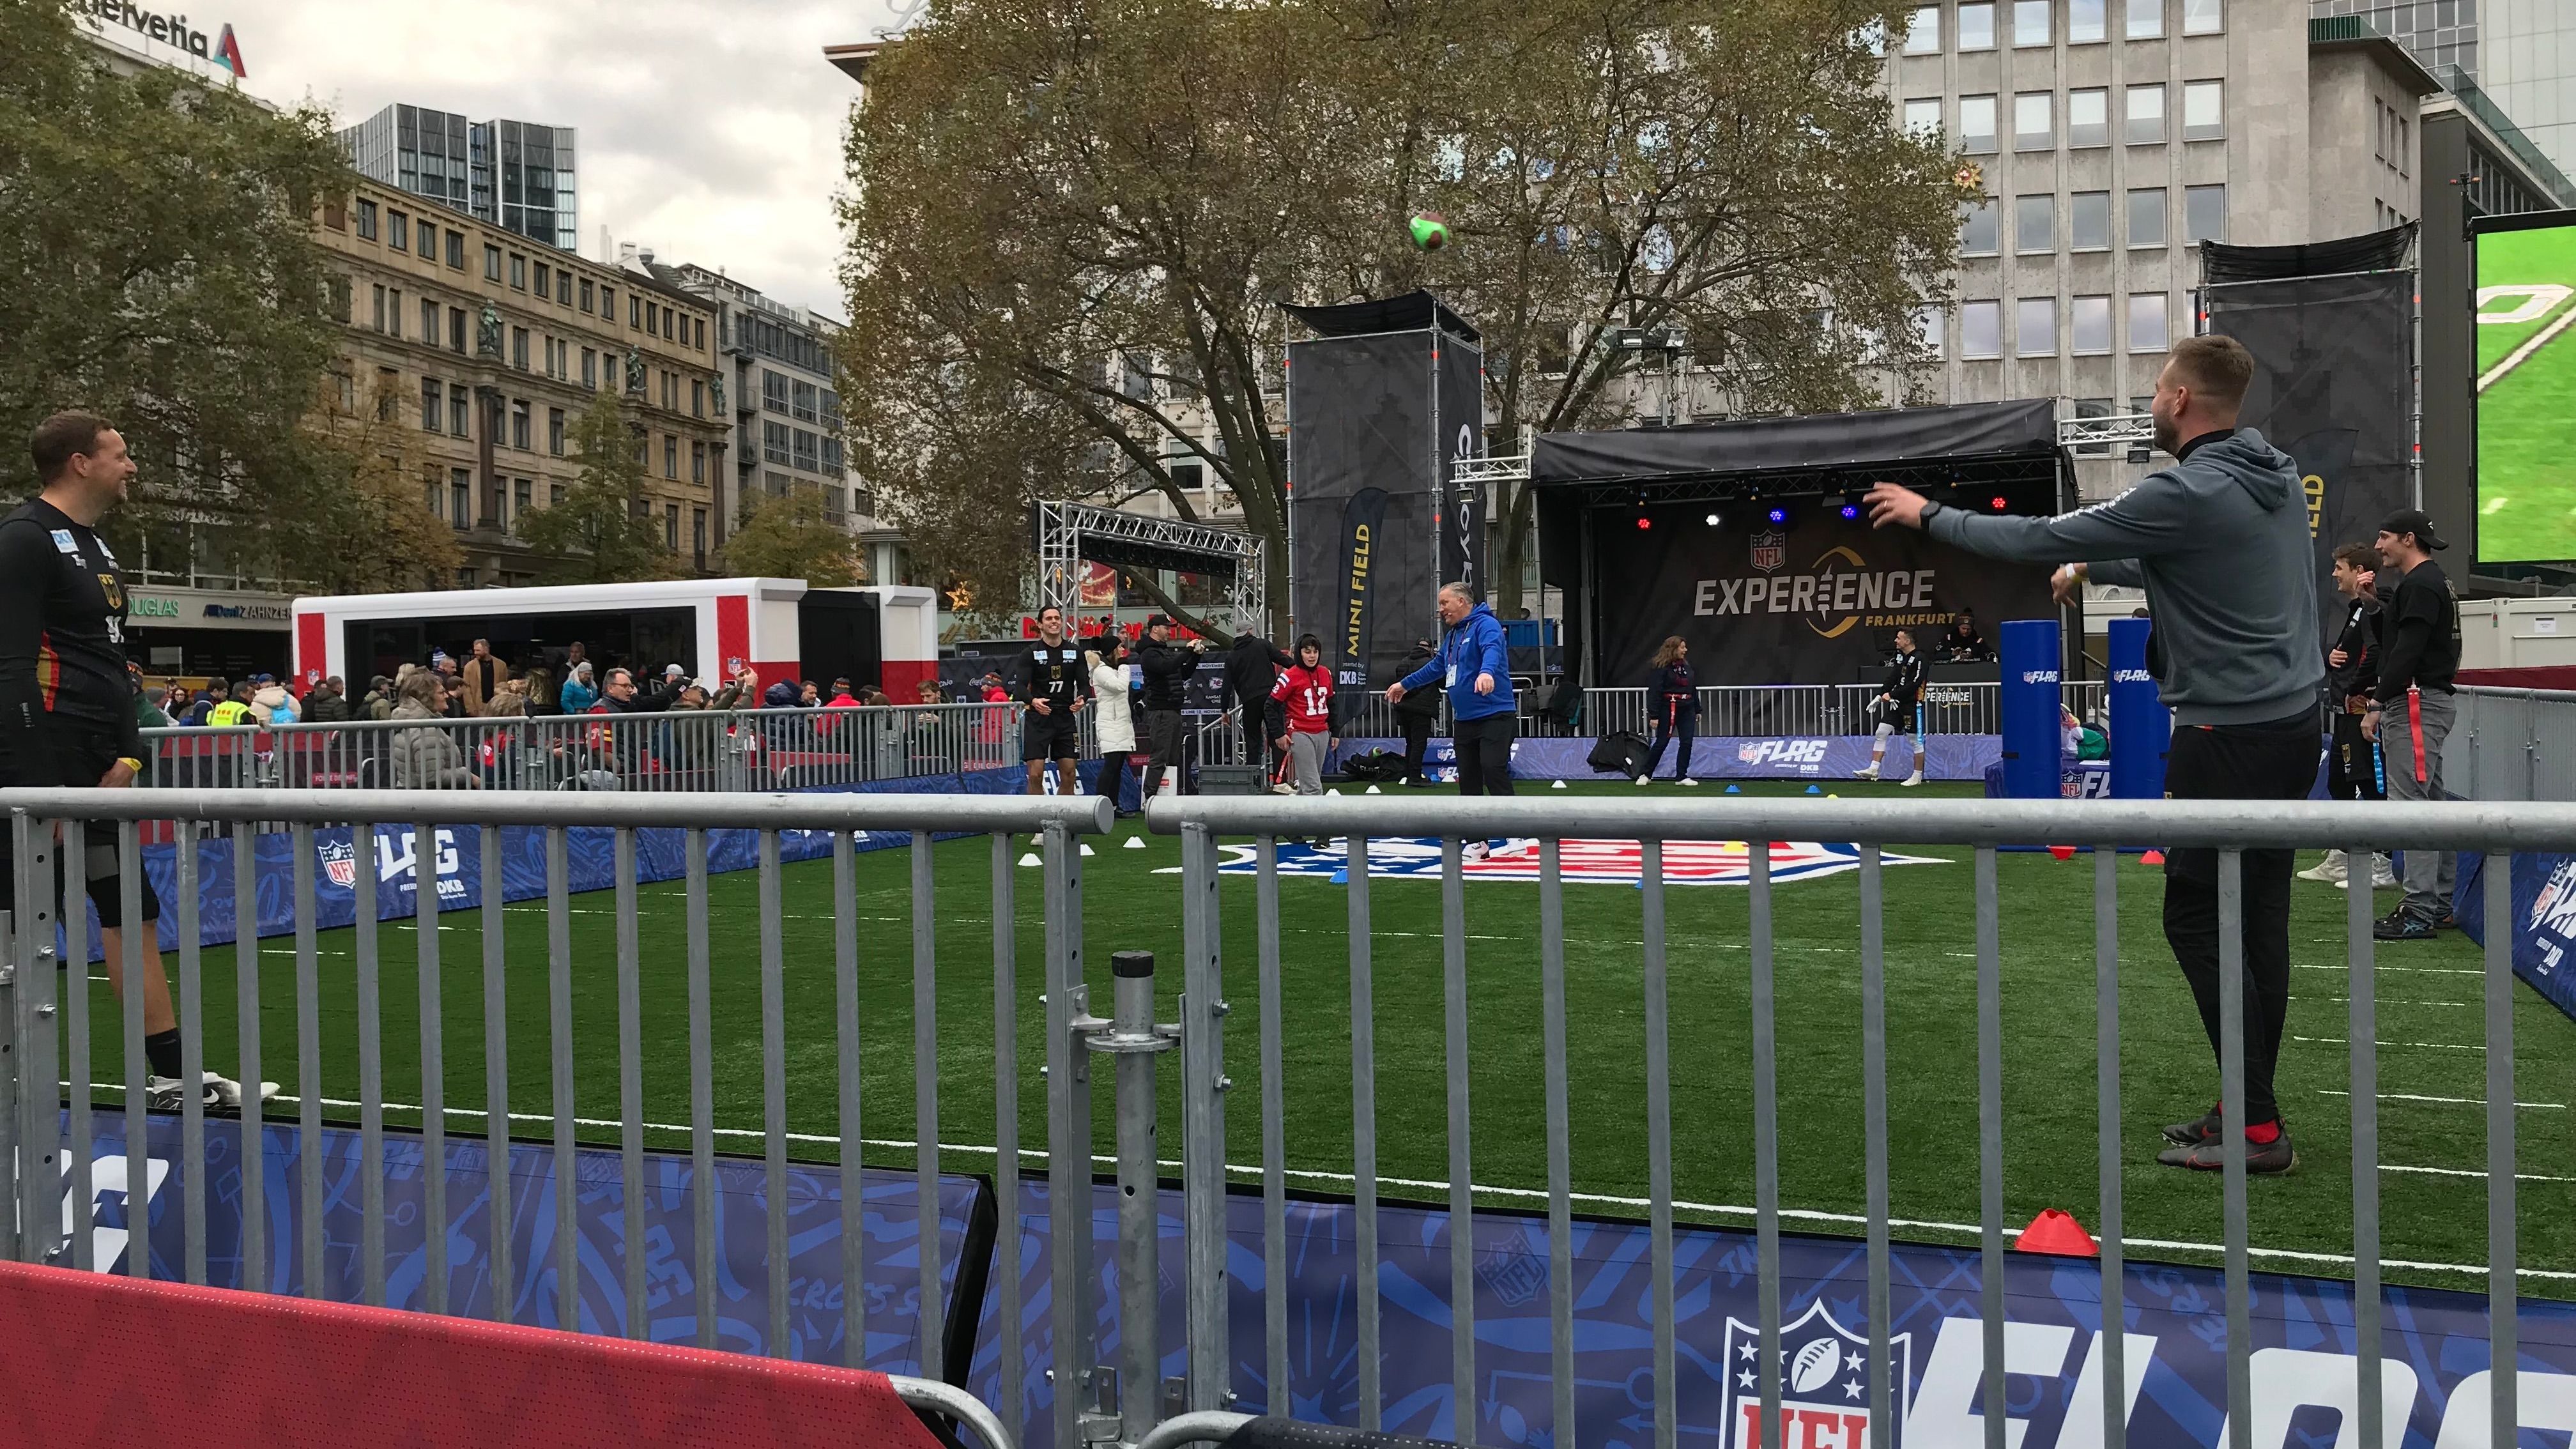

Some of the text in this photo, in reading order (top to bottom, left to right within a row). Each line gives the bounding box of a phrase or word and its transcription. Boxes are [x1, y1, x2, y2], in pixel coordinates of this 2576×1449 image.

[1754, 548, 1781, 567] NFL
[1347, 524, 1370, 657] MINI FIELD
[1694, 567, 1935, 617] EXPERIENCE
[1865, 612, 1956, 627] FRANKFURT
[1339, 671, 1357, 685] DKB
[2030, 671, 2058, 684] FLAG
[2119, 670, 2150, 683] FLAG
[1048, 681, 1064, 693] 77
[1304, 686, 1329, 716] 12
[1741, 740, 1828, 765] NFL FLAG
[2062, 784, 2080, 797] NFL
[436, 879, 465, 894] DKB
